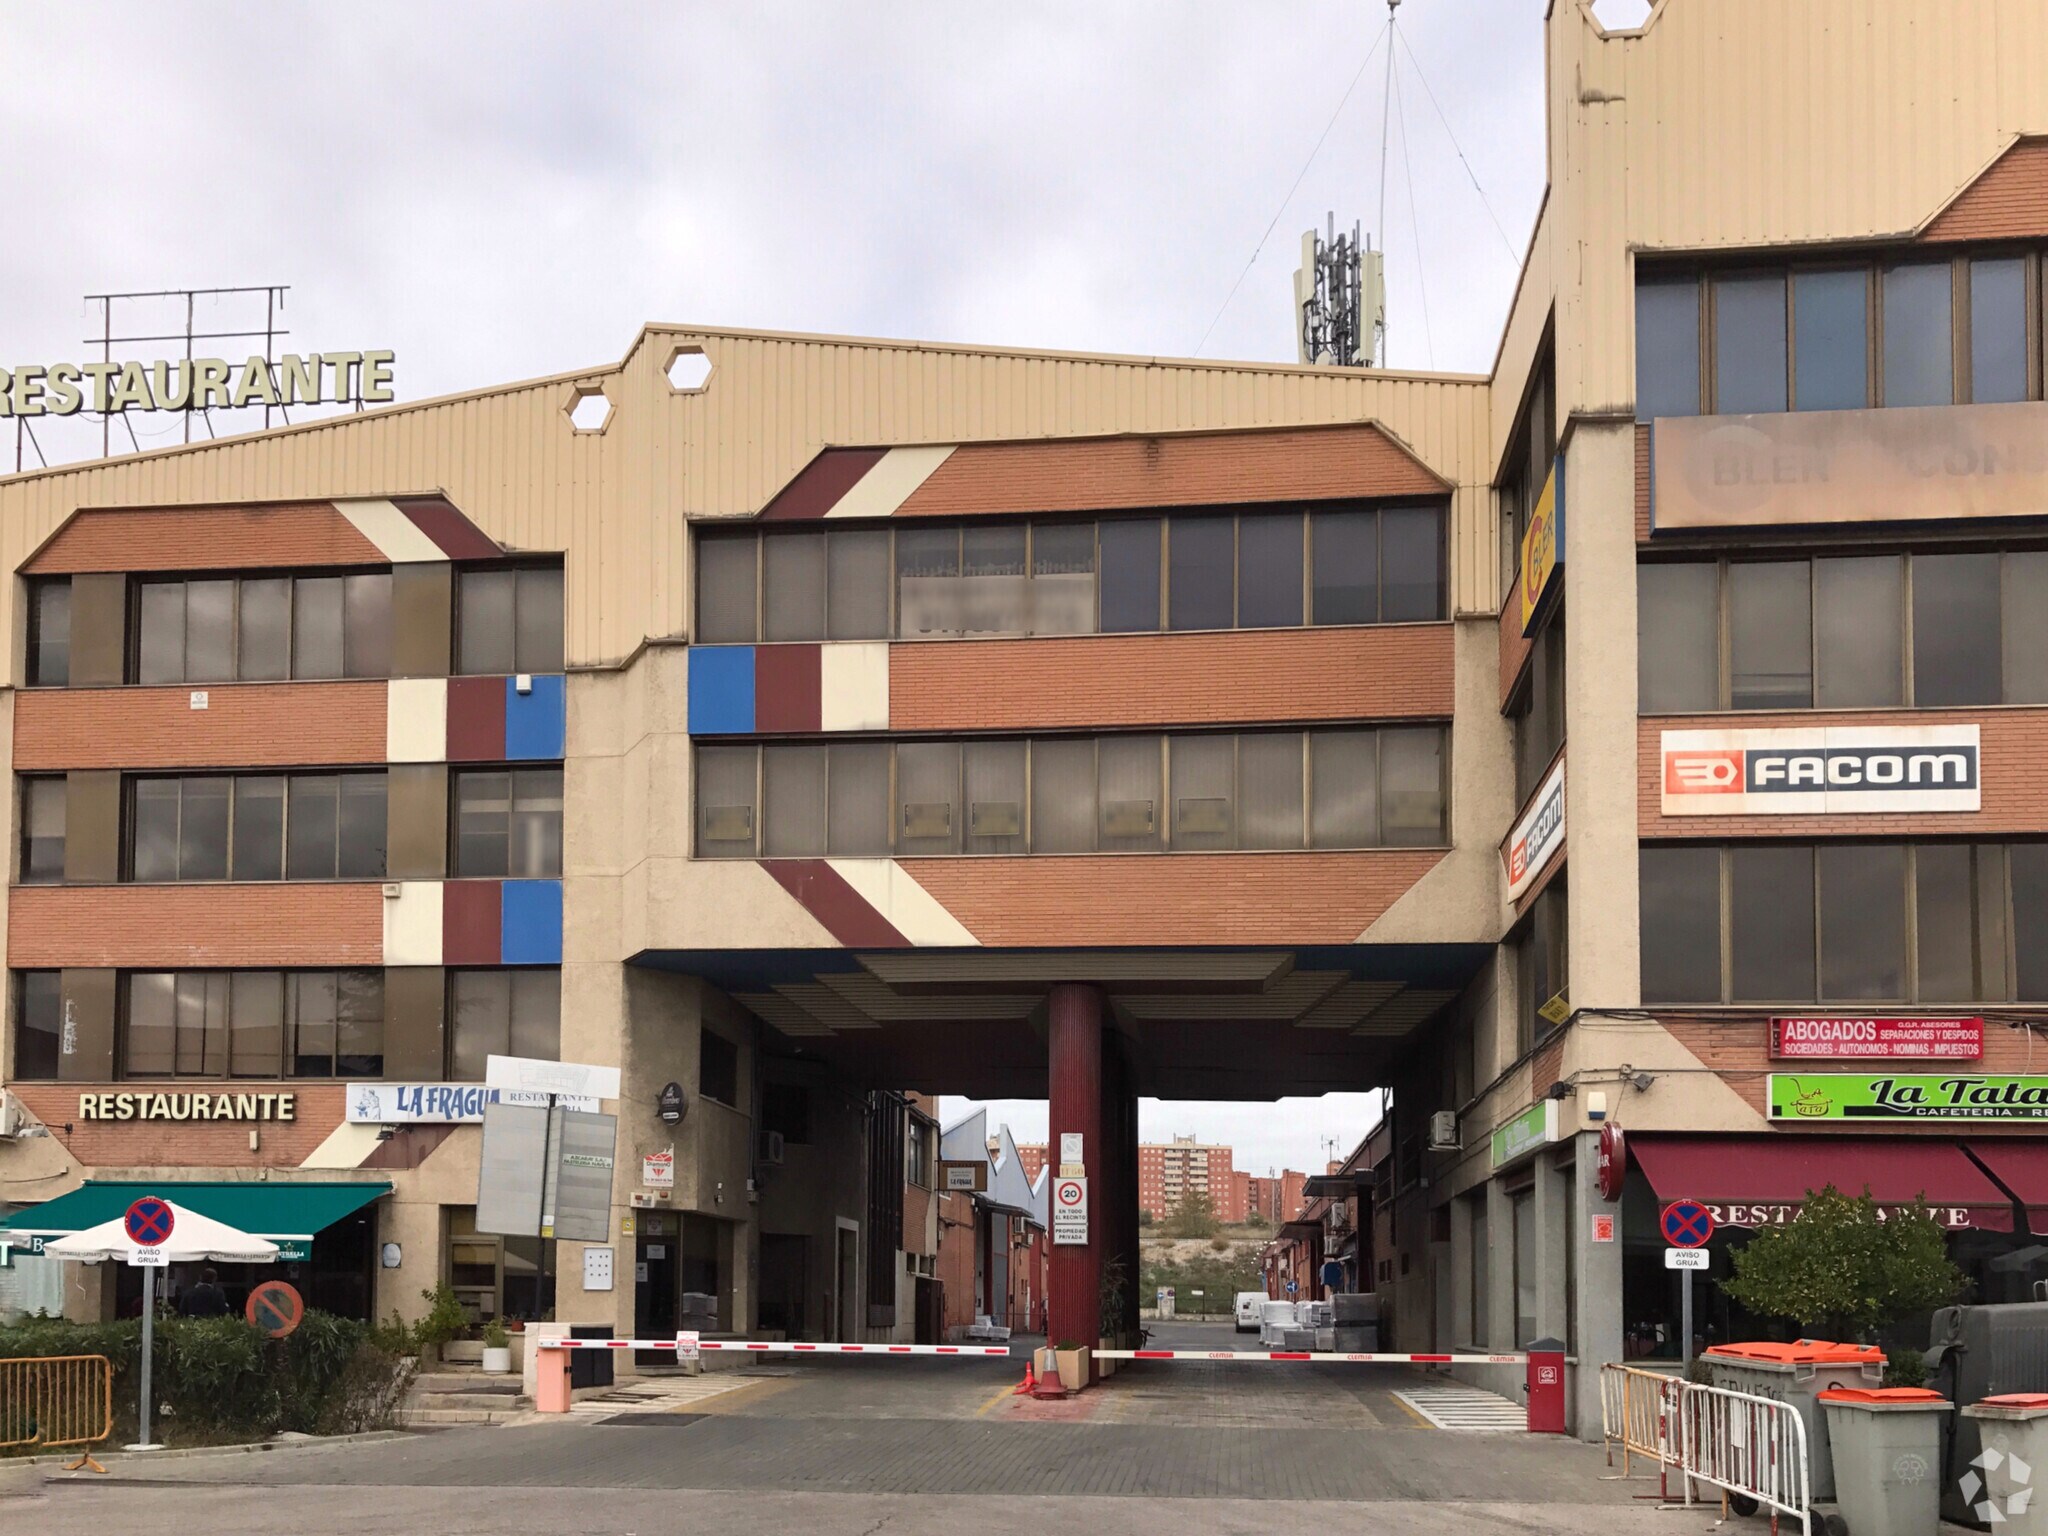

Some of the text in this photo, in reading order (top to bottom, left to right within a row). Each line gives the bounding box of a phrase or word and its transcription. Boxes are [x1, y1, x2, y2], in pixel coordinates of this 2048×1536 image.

[1755, 753, 1967, 785] FACOM
[1527, 791, 1561, 862] FACOM
[1784, 1021, 1876, 1041] ABOGADOS
[1880, 1030, 1979, 1040] SEPARACIONES Y DESPIDOS
[1784, 1043, 1833, 1054] SOCIEDADES
[1838, 1043, 1888, 1054] AUTONOMOS
[1893, 1043, 1929, 1054] NOMINAS
[1935, 1043, 1979, 1054] IMPUESTOS
[79, 1093, 295, 1121] RESTAURANTE
[397, 1085, 424, 1118] LA
[1870, 1079, 2048, 1112] La Tata
[1916, 1108, 2012, 1116] CAFETERIA
[1064, 1190, 1077, 1198] 20
